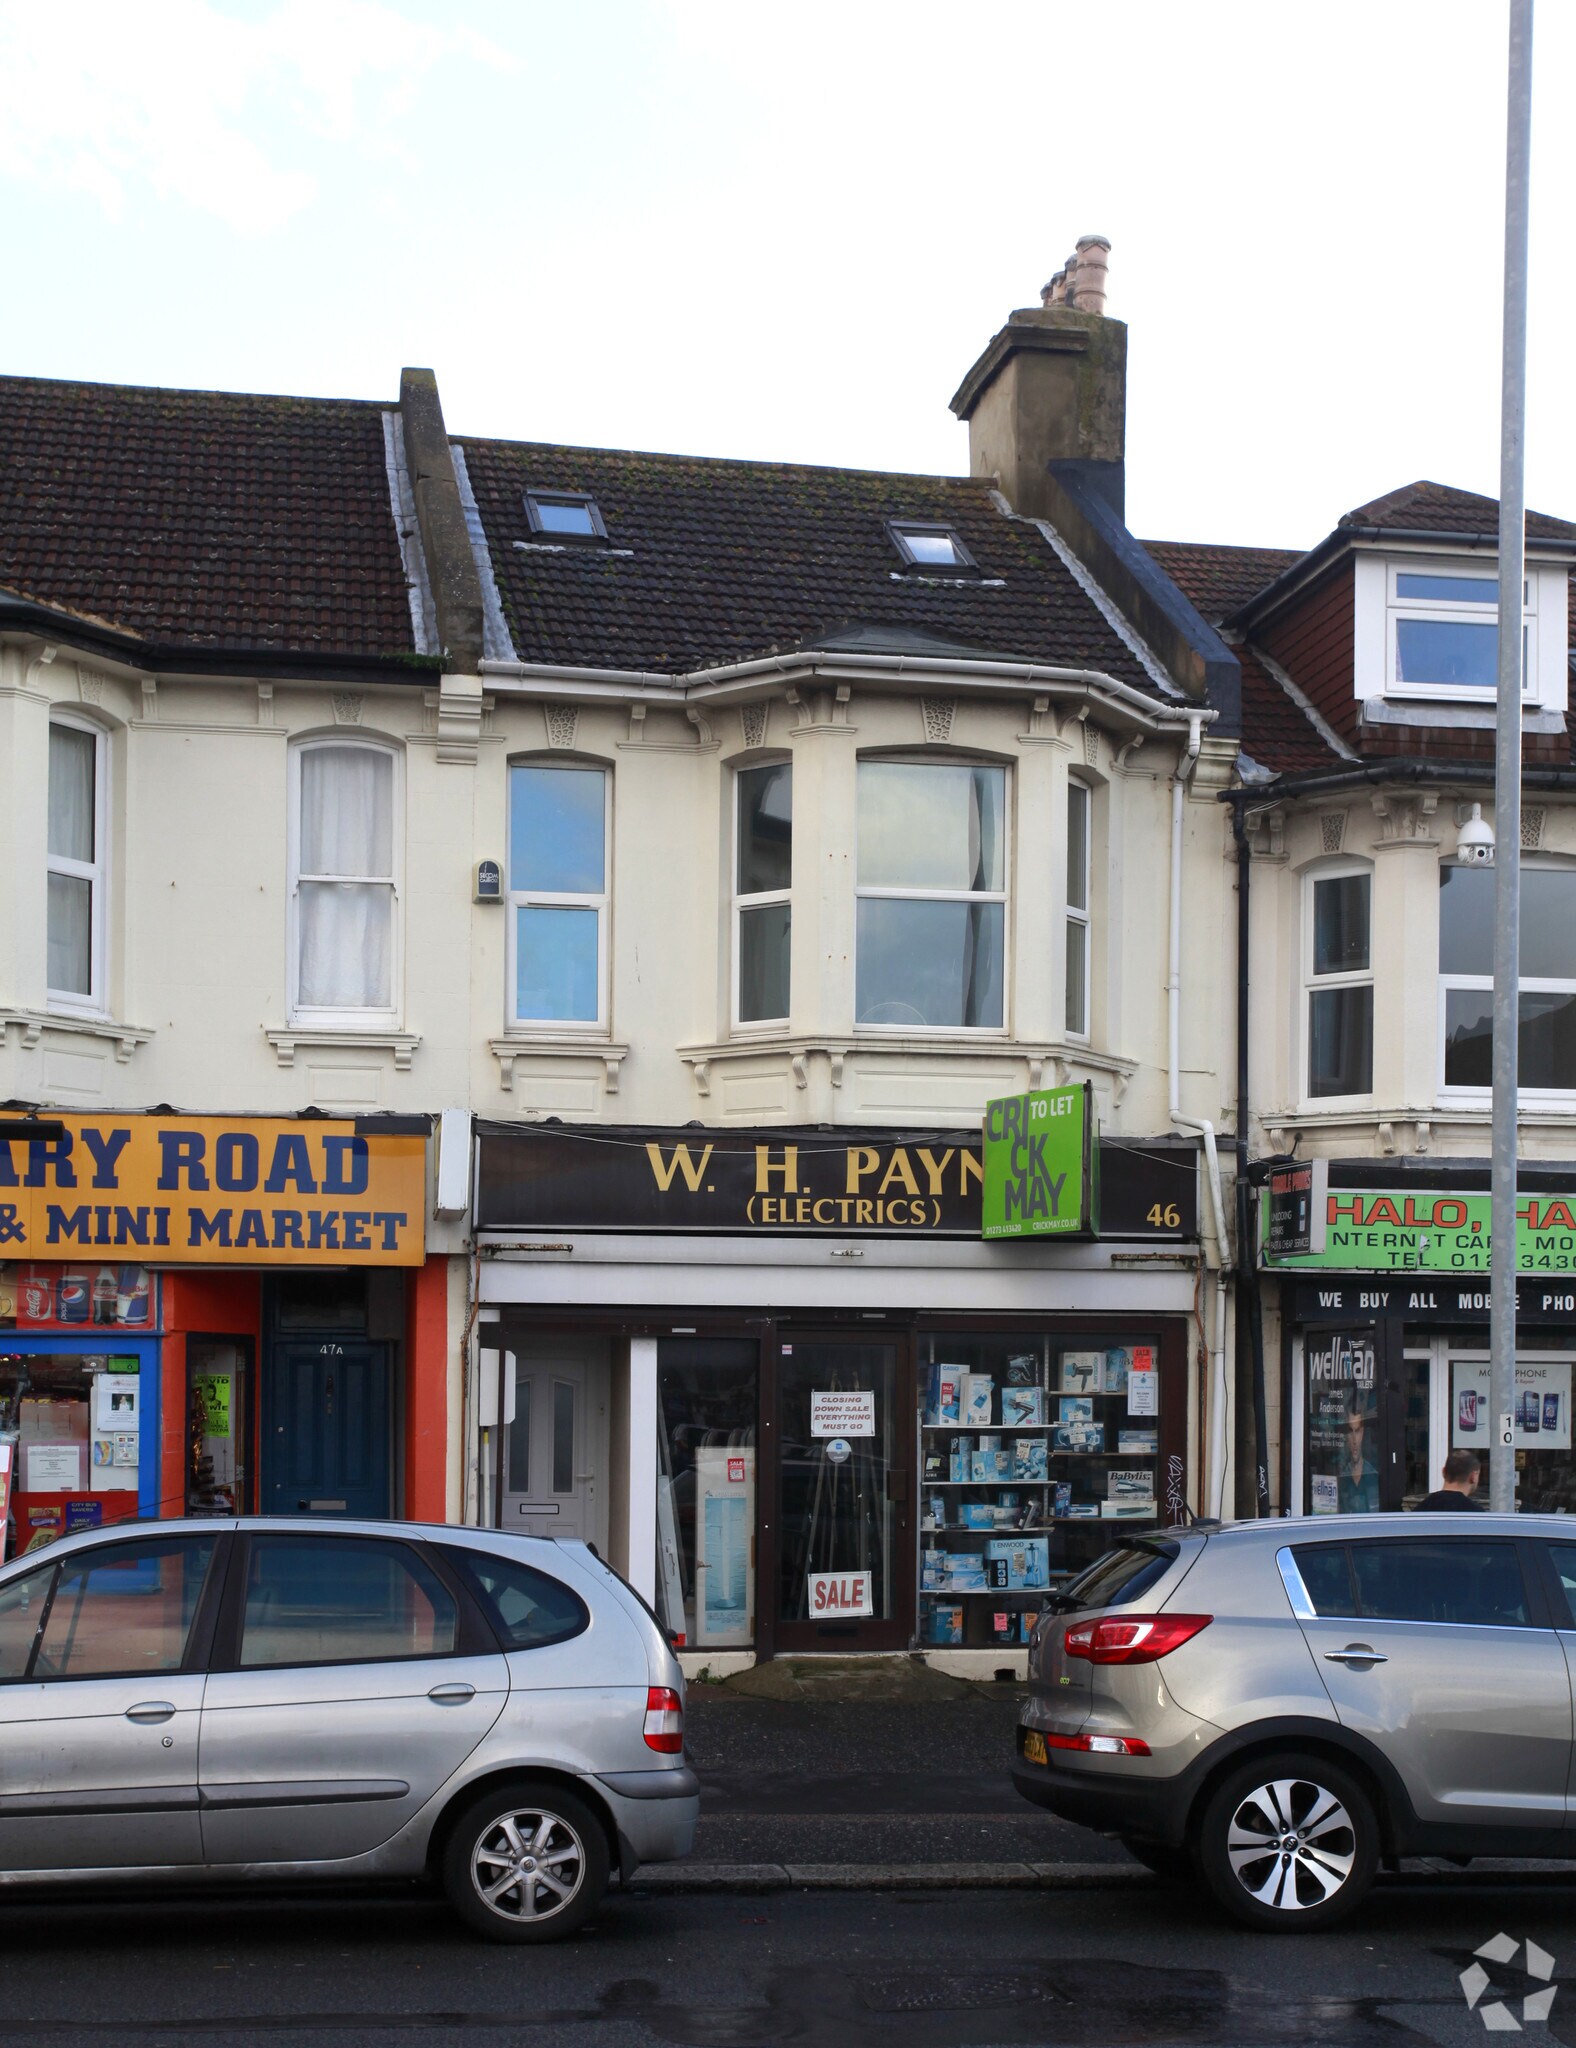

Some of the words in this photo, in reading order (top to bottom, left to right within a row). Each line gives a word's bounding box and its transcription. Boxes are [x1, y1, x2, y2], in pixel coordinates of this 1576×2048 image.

[1031, 1101, 1047, 1120] TO
[1050, 1095, 1074, 1117] LET
[157, 1130, 370, 1195] ROAD
[645, 1143, 715, 1192] W.
[755, 1146, 811, 1194] H.
[846, 1146, 983, 1196] PAYN
[746, 1196, 942, 1227] (ELECTRICS)
[1146, 1203, 1181, 1228] 46
[1326, 1196, 1482, 1233] HALO,
[46, 1204, 171, 1246] MINI
[187, 1208, 408, 1250] MARKET
[1032, 1218, 1079, 1231] CRICKMAY.CO.UK
[1332, 1232, 1446, 1249] NTERNT
[1388, 1252, 1438, 1267] TEL.
[1319, 1292, 1342, 1309] WE
[1359, 1292, 1390, 1309] BUY
[1408, 1292, 1438, 1310] ALL
[1542, 1295, 1575, 1312] PHO
[319, 1344, 344, 1355] 47A
[1310, 1337, 1375, 1380] wellman
[1515, 1369, 1547, 1378] PHONE
[814, 1579, 864, 1609] SALE
